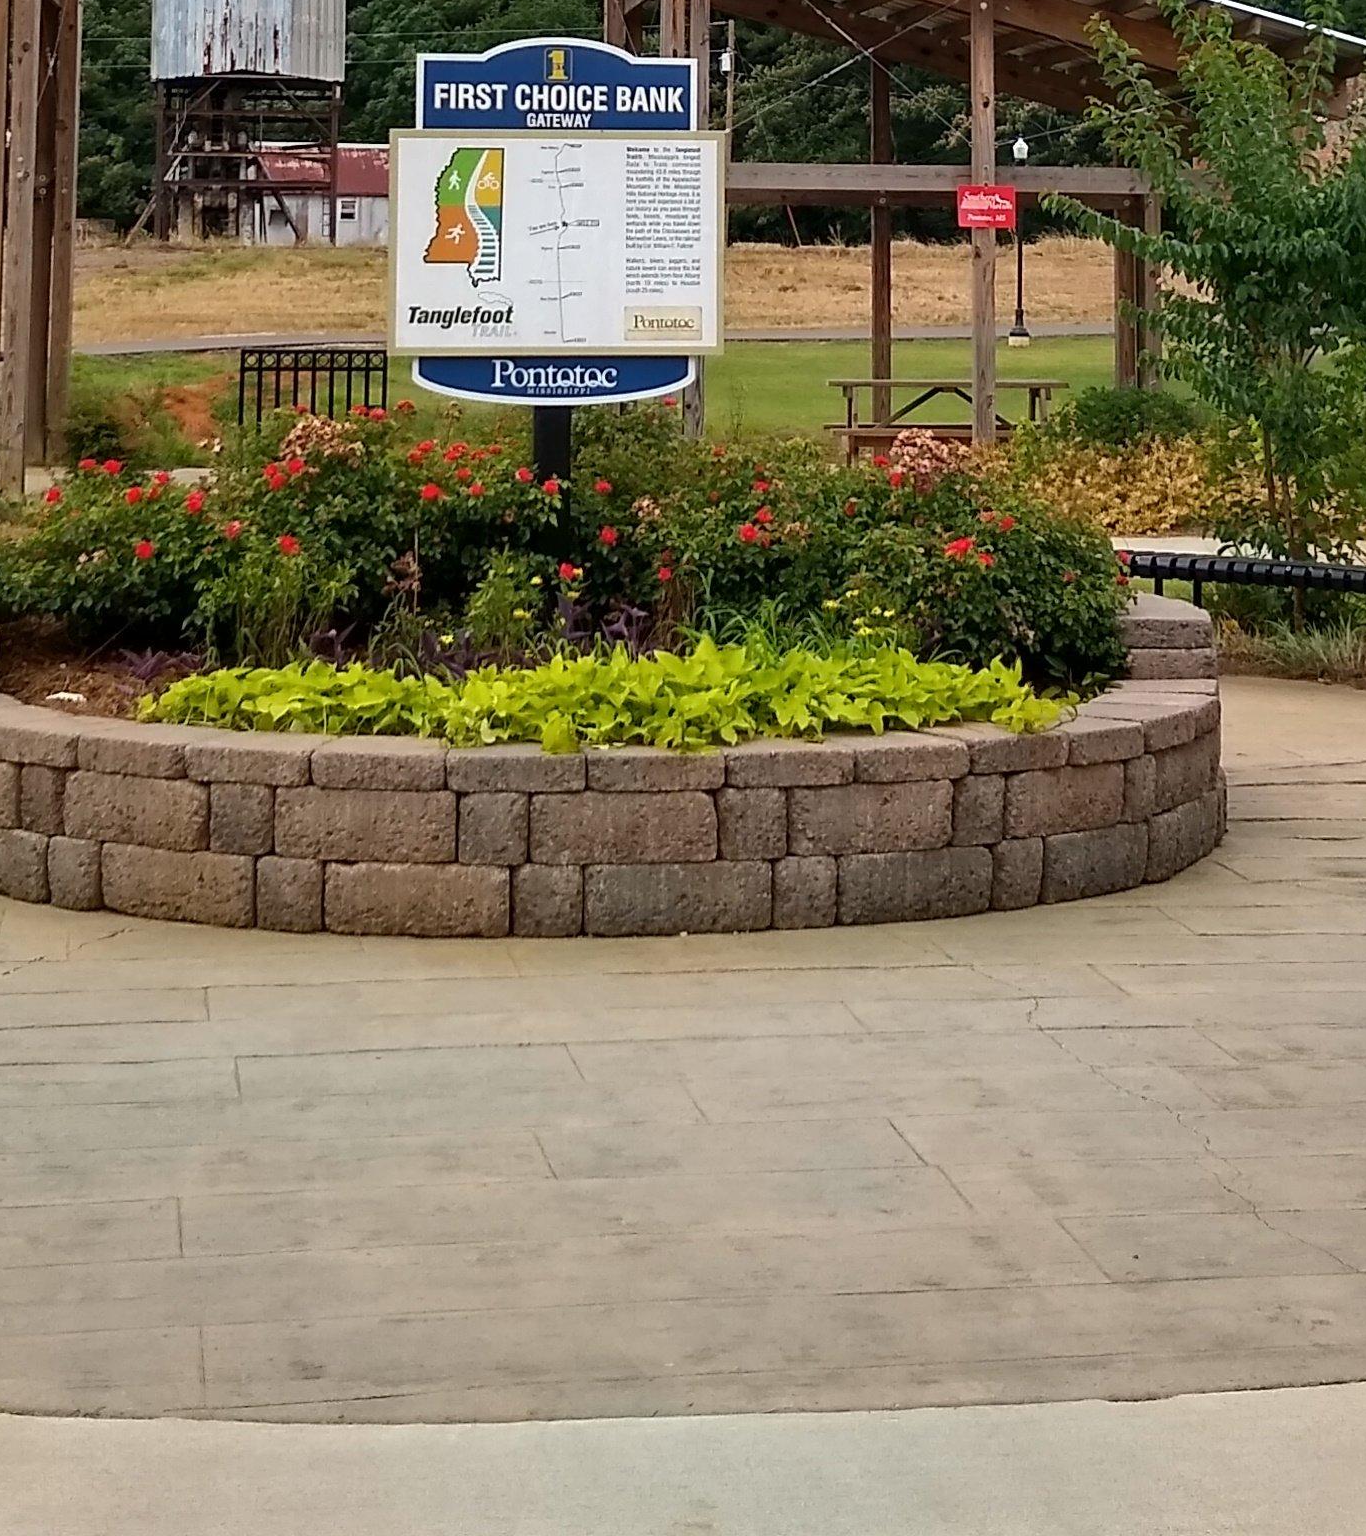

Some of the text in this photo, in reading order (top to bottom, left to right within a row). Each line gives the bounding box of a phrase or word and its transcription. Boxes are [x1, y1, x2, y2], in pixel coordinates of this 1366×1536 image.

[435, 83, 684, 113] FIRST CHOICE BANK
[526, 113, 592, 128] GATEWAY
[408, 305, 514, 329] Tanglefoot
[634, 314, 695, 329] Pontotoc
[491, 359, 618, 388] Pontotoc
